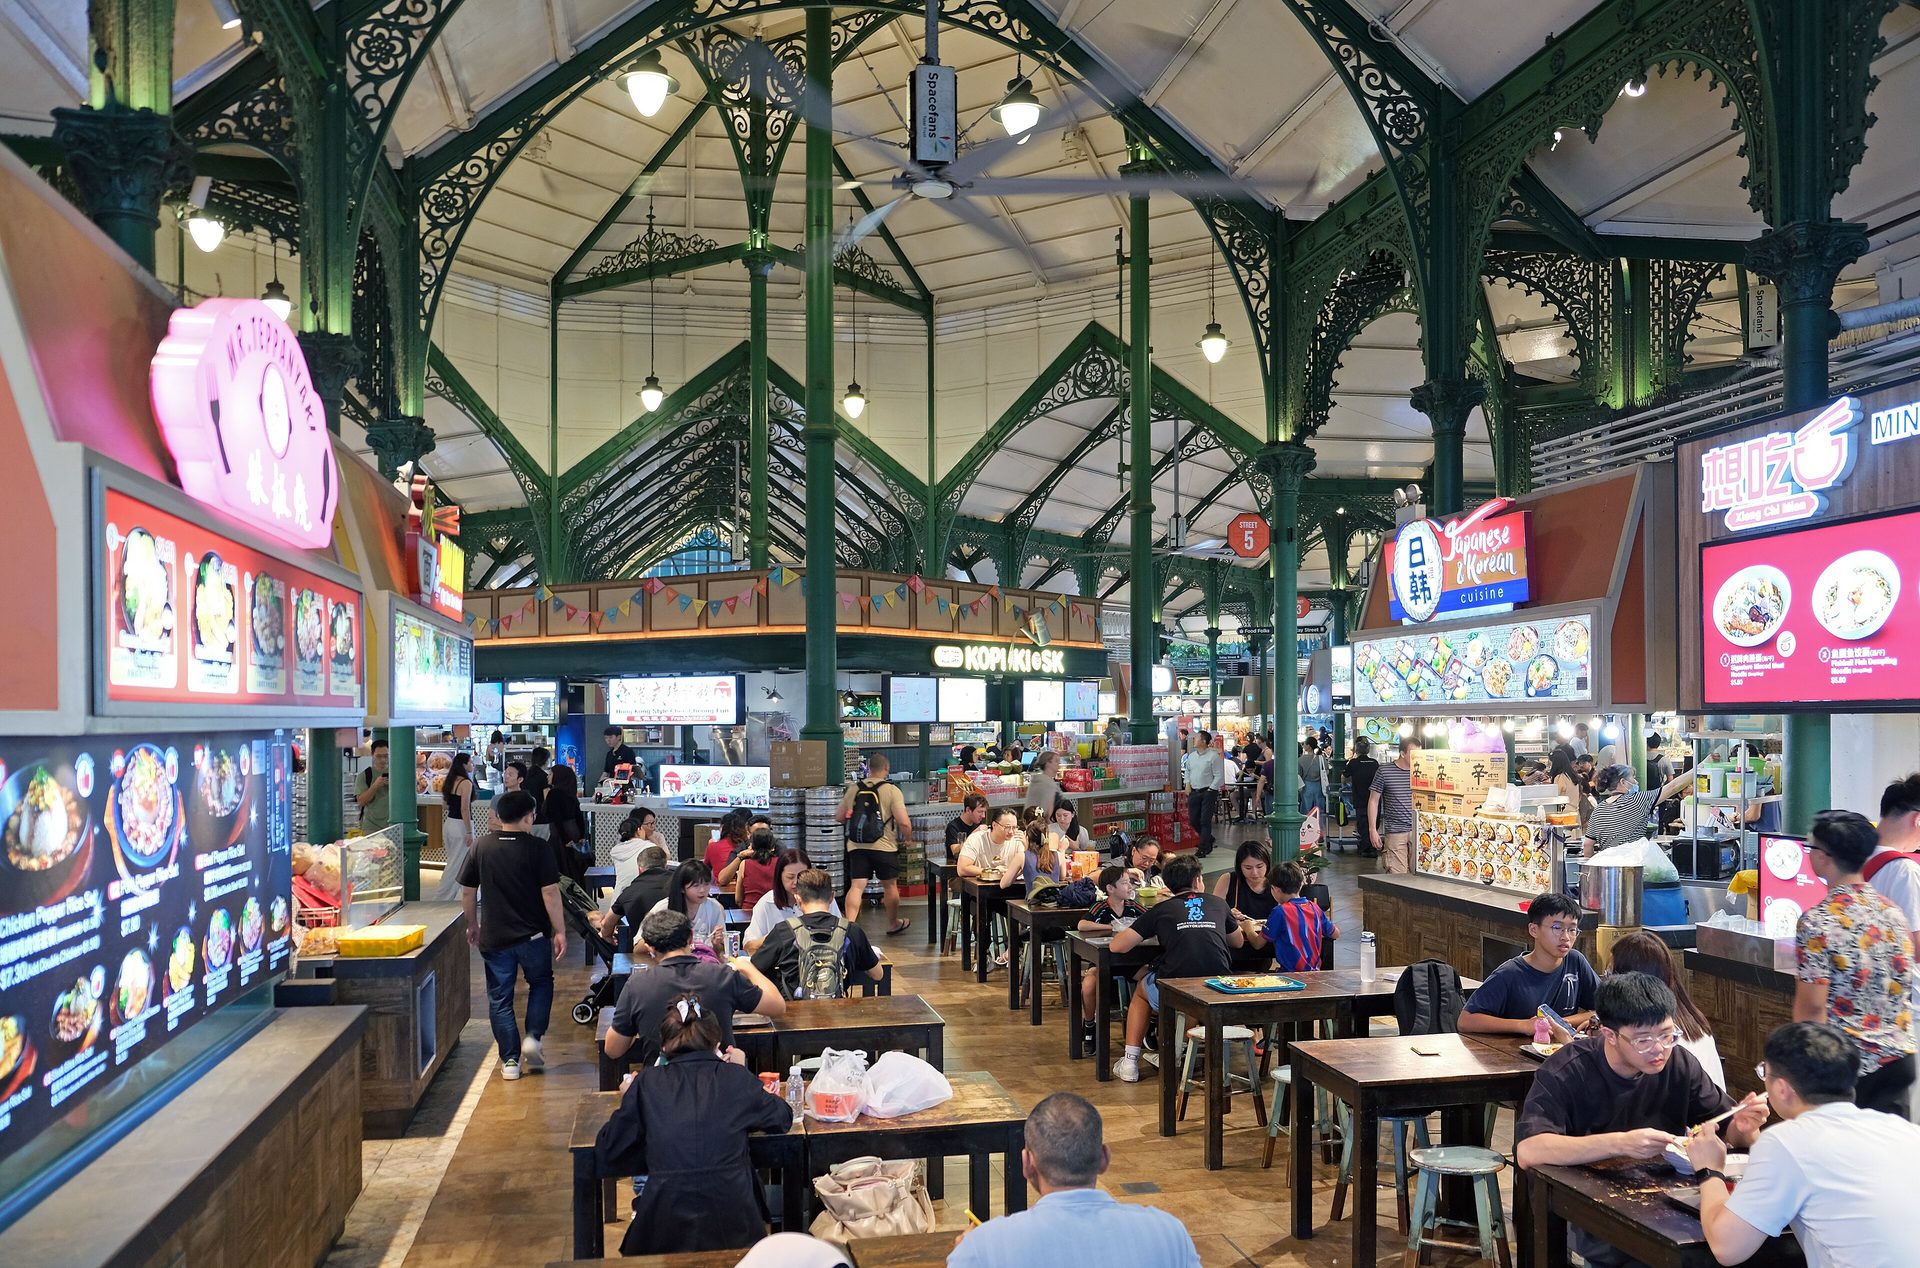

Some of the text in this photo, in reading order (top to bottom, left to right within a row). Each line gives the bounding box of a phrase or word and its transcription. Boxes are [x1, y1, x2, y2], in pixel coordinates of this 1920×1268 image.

[927, 72, 939, 138] Spacefans
[1756, 289, 1765, 334] Spacefans
[1875, 406, 1919, 440] MIN
[1239, 521, 1258, 529] STREET
[1244, 530, 1254, 550] 5
[1443, 520, 1510, 563] Japanese
[1466, 551, 1518, 585] Korean
[1460, 586, 1504, 604] cuisine
[964, 645, 1007, 672] KOPI
[1012, 647, 1065, 674] KIOSK
[1687, 719, 1696, 729] 15
[0, 911, 36, 938] Chicken
[36, 902, 66, 926] Pepper
[66, 895, 84, 916] Rice
[83, 889, 99, 909] Set
